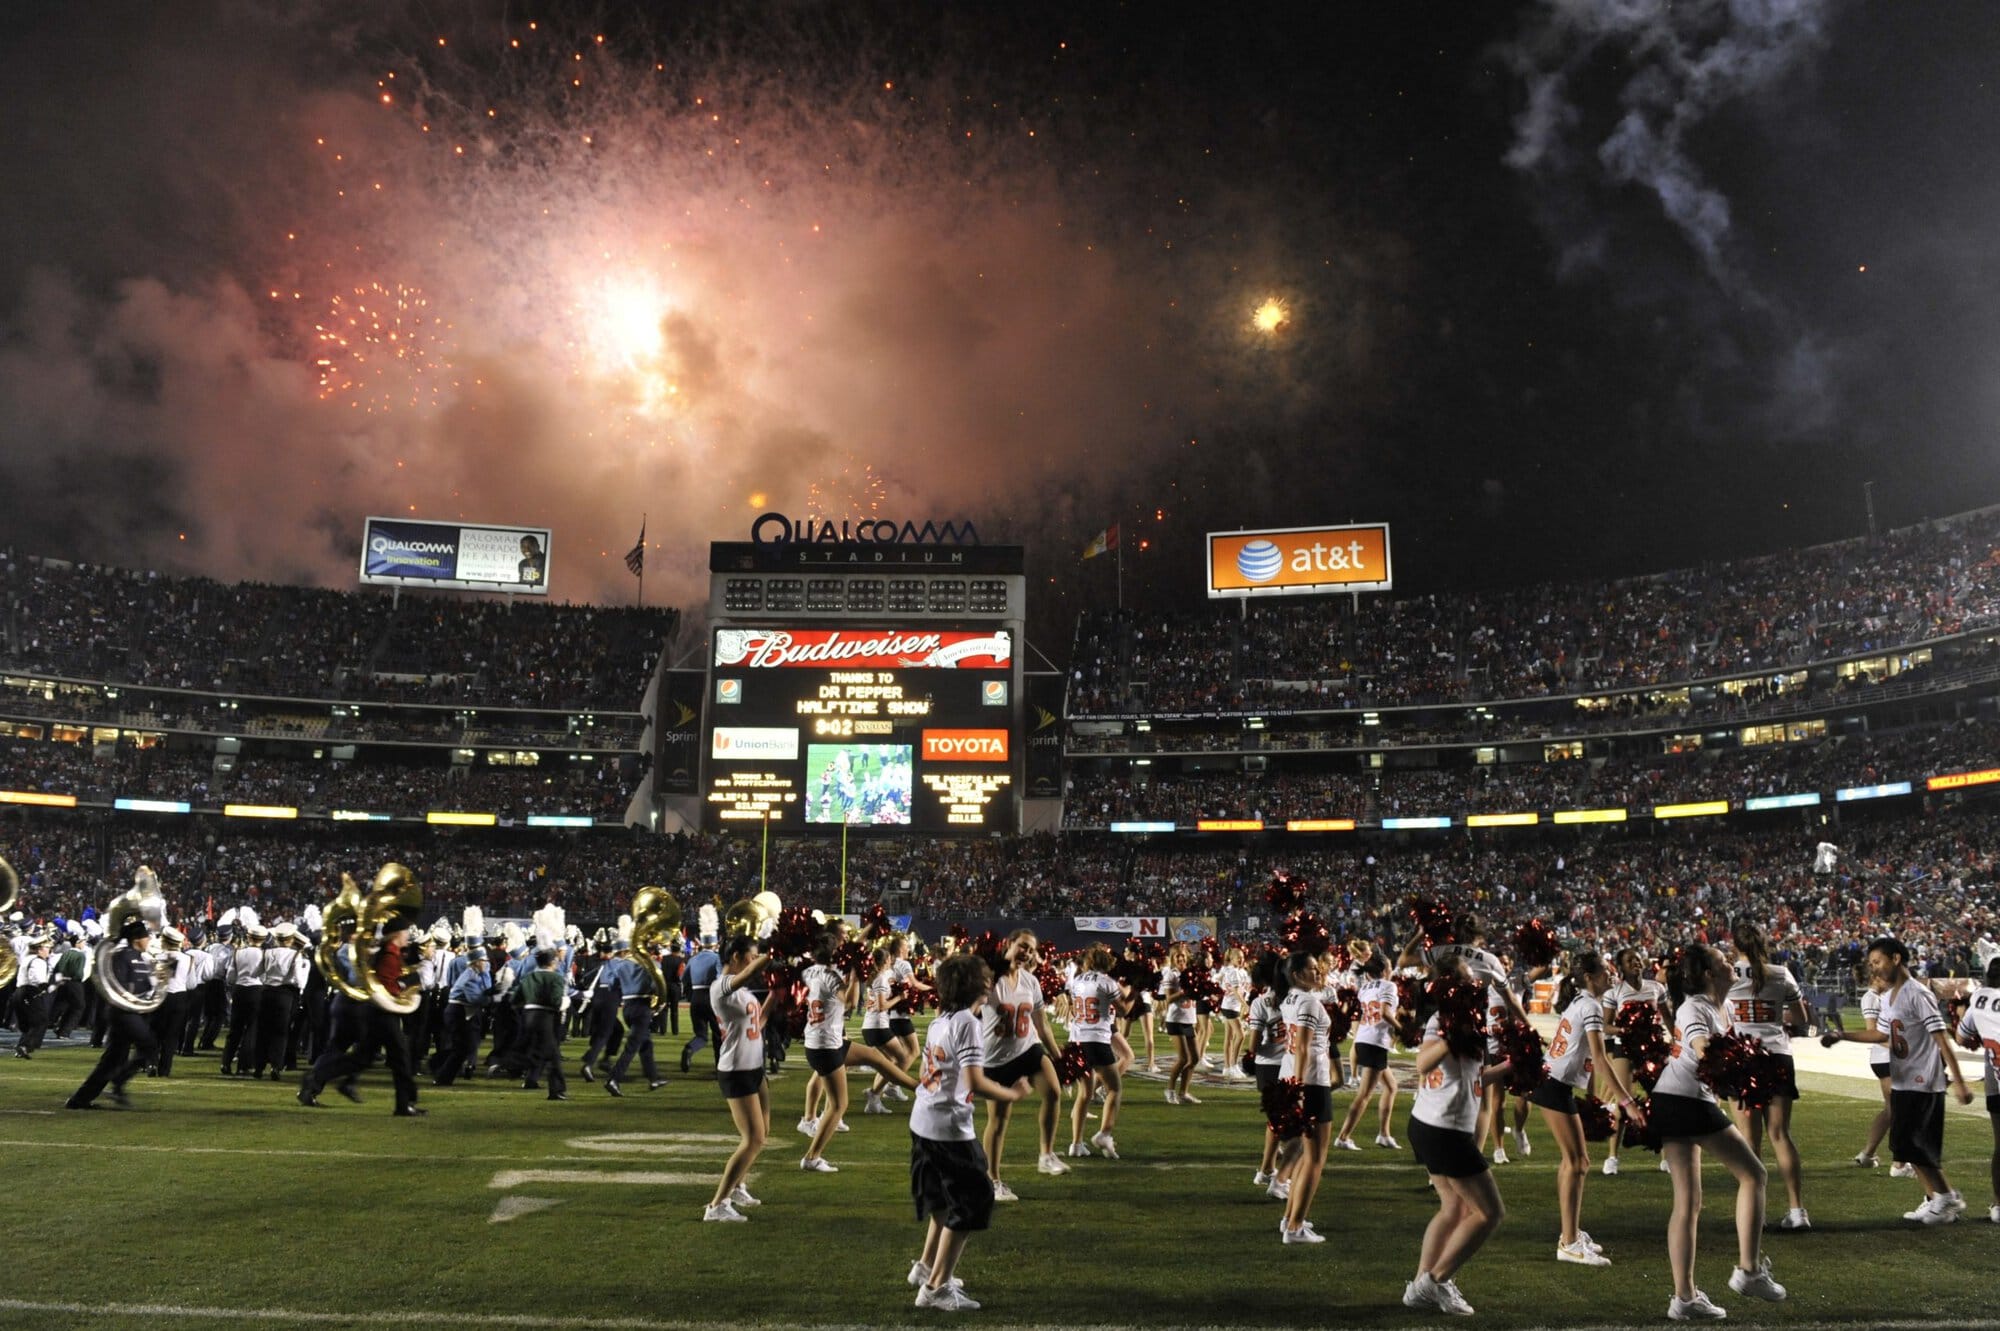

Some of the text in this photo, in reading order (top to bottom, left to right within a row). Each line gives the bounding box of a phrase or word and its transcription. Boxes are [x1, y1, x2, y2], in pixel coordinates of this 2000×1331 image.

[463, 534, 519, 544] PALOMAR
[751, 512, 981, 560] QUALCOMM
[371, 537, 454, 555] QUALCOMM
[462, 543, 518, 553] POMERADO
[386, 555, 440, 566] Innovation
[462, 552, 518, 562] HEALTH
[799, 552, 963, 562] STADIUM
[1291, 540, 1365, 572] at&t
[743, 630, 941, 667] Budweiser
[830, 672, 894, 684] THANKS TO
[819, 685, 903, 699] DR PEPPER
[796, 701, 930, 715] HALFTIME SHOW
[735, 739, 796, 749] UnionBank
[926, 738, 1005, 754] TOYOTA
[1139, 918, 1159, 936] N
[1731, 999, 1777, 1023] 36
[746, 1002, 762, 1040] 3
[994, 1002, 1033, 1039] 36
[1890, 1018, 1909, 1060] 6
